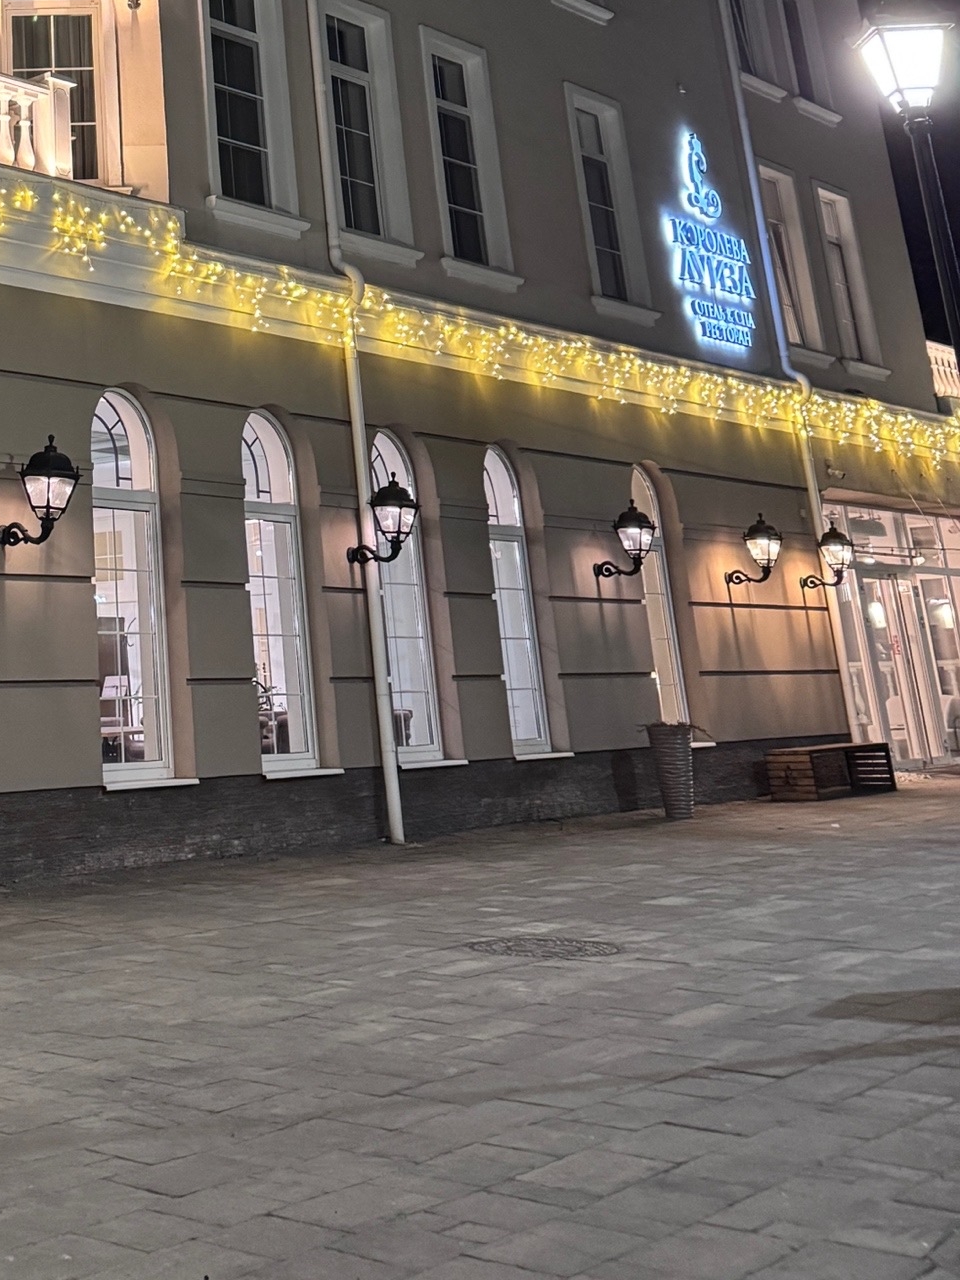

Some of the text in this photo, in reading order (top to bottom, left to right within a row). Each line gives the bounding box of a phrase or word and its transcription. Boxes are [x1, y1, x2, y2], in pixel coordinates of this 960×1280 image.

[671, 218, 751, 264] КОРОЛЕВА
[679, 248, 756, 299] ЛУИЗА
[691, 300, 725, 322] ОТЕЛЬ
[735, 309, 756, 329] СПА
[700, 321, 752, 347] РЕСТОРАН
